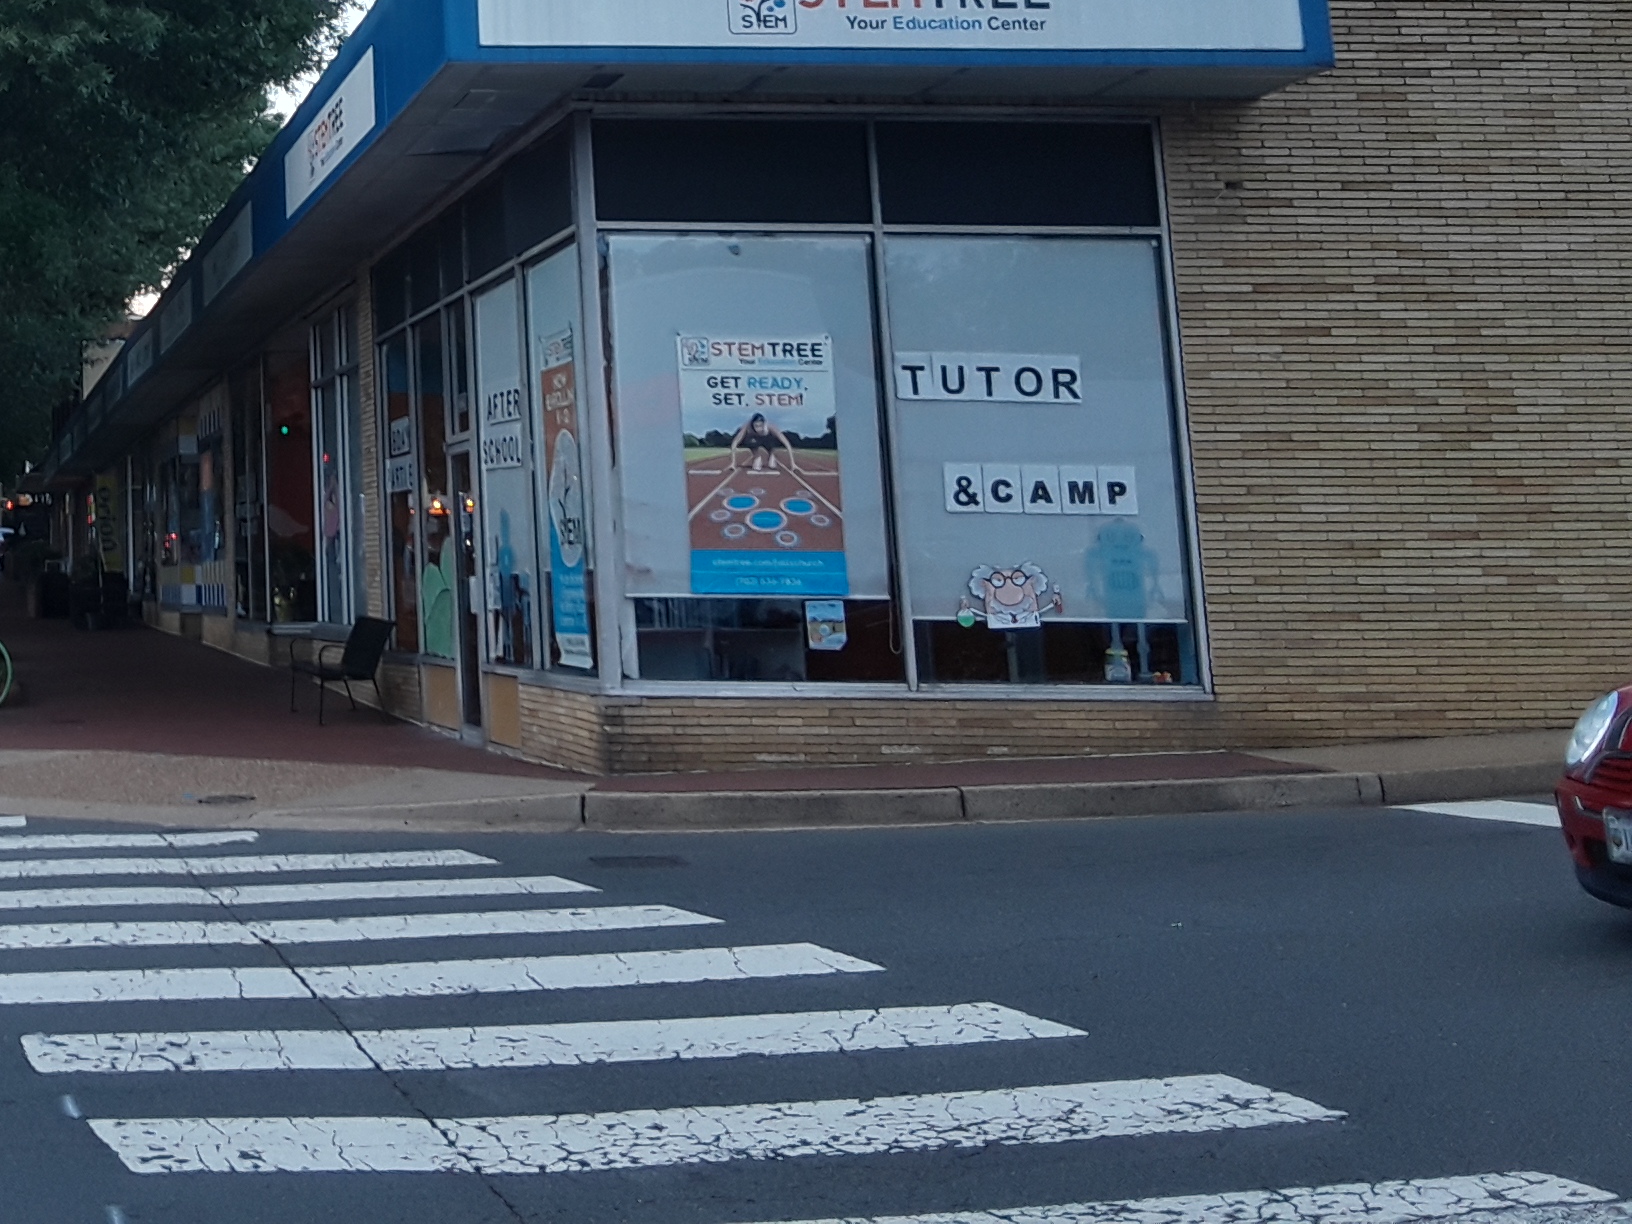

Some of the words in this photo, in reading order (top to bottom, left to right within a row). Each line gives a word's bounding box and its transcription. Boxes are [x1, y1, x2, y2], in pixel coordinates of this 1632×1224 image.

[846, 15, 887, 31] Your
[893, 15, 982, 31] Education
[987, 16, 1047, 31] Center
[710, 341, 824, 358] STEMTREE
[706, 376, 742, 389] GET
[901, 364, 1082, 400] TUTOR
[487, 388, 522, 421] AFTER
[754, 393, 804, 407] STEM!
[483, 435, 521, 465] SCHOOL
